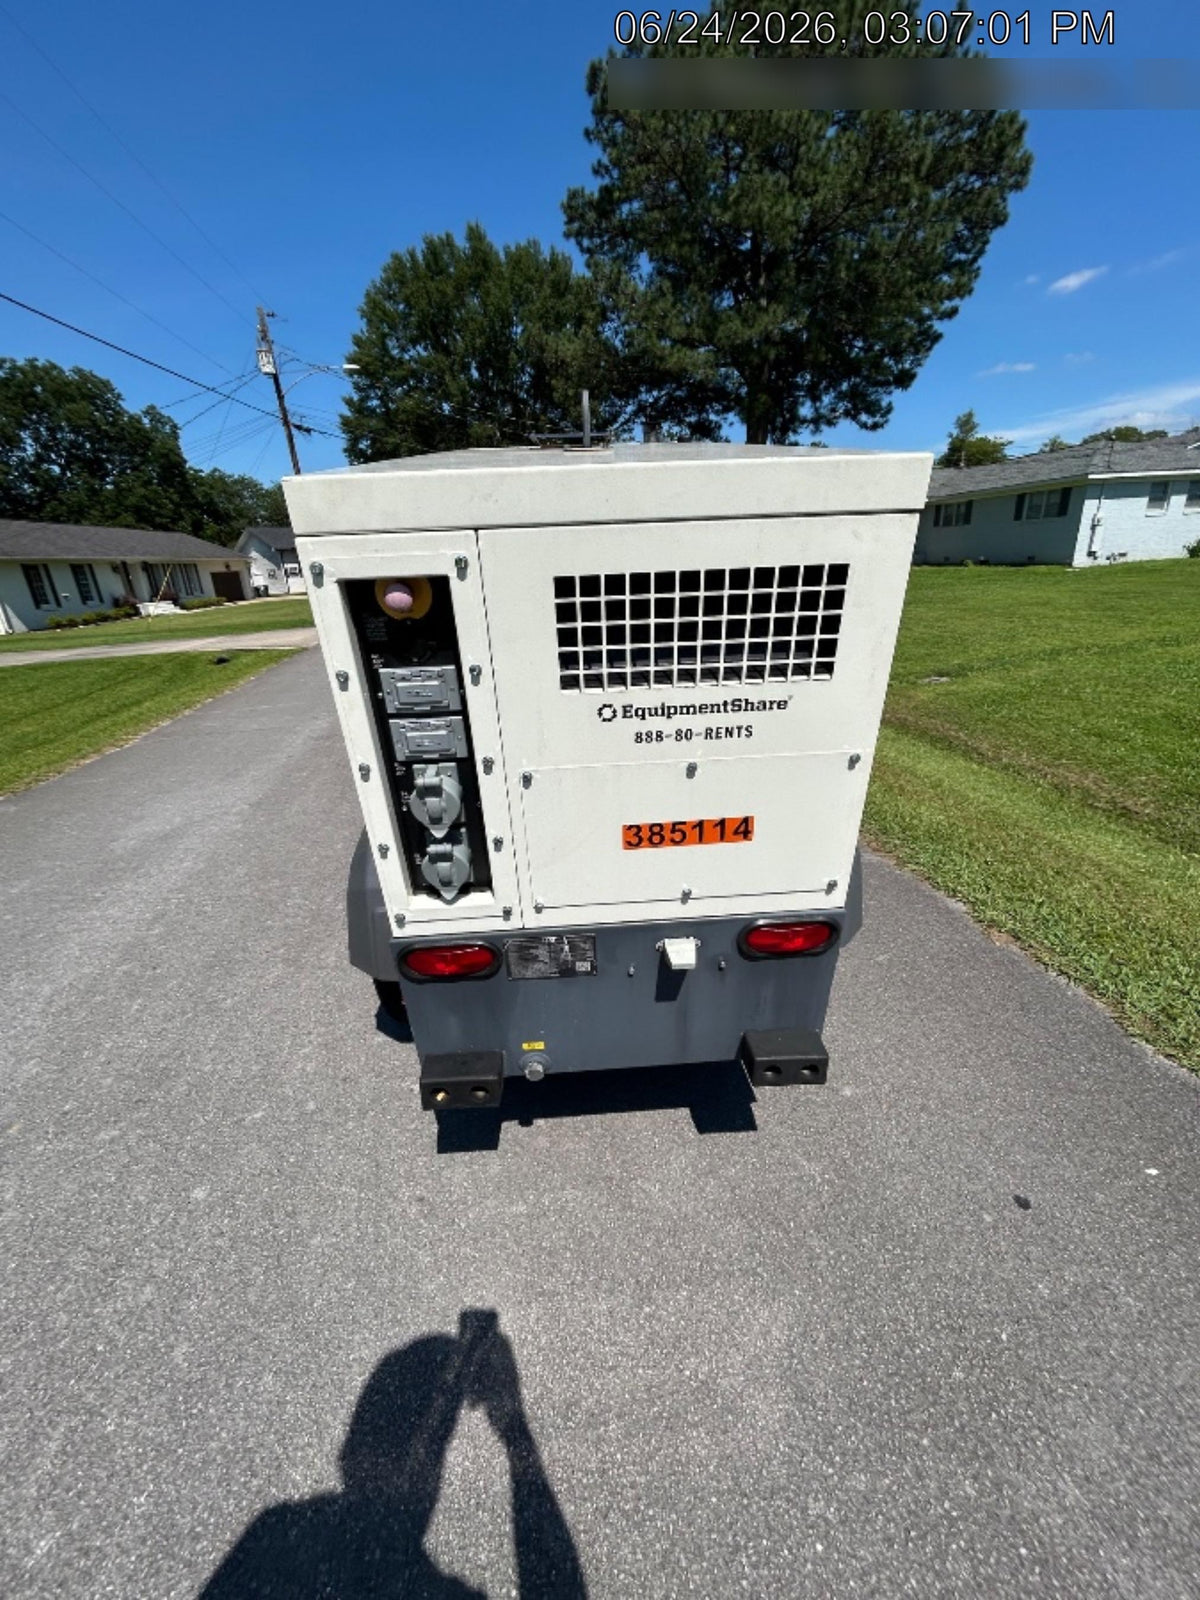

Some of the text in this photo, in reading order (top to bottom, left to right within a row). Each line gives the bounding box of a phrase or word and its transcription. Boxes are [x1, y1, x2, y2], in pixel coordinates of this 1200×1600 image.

[621, 698, 789, 720] EquipmentShare
[634, 725, 754, 744] 888-80-RENTS
[625, 816, 753, 847] 385114
